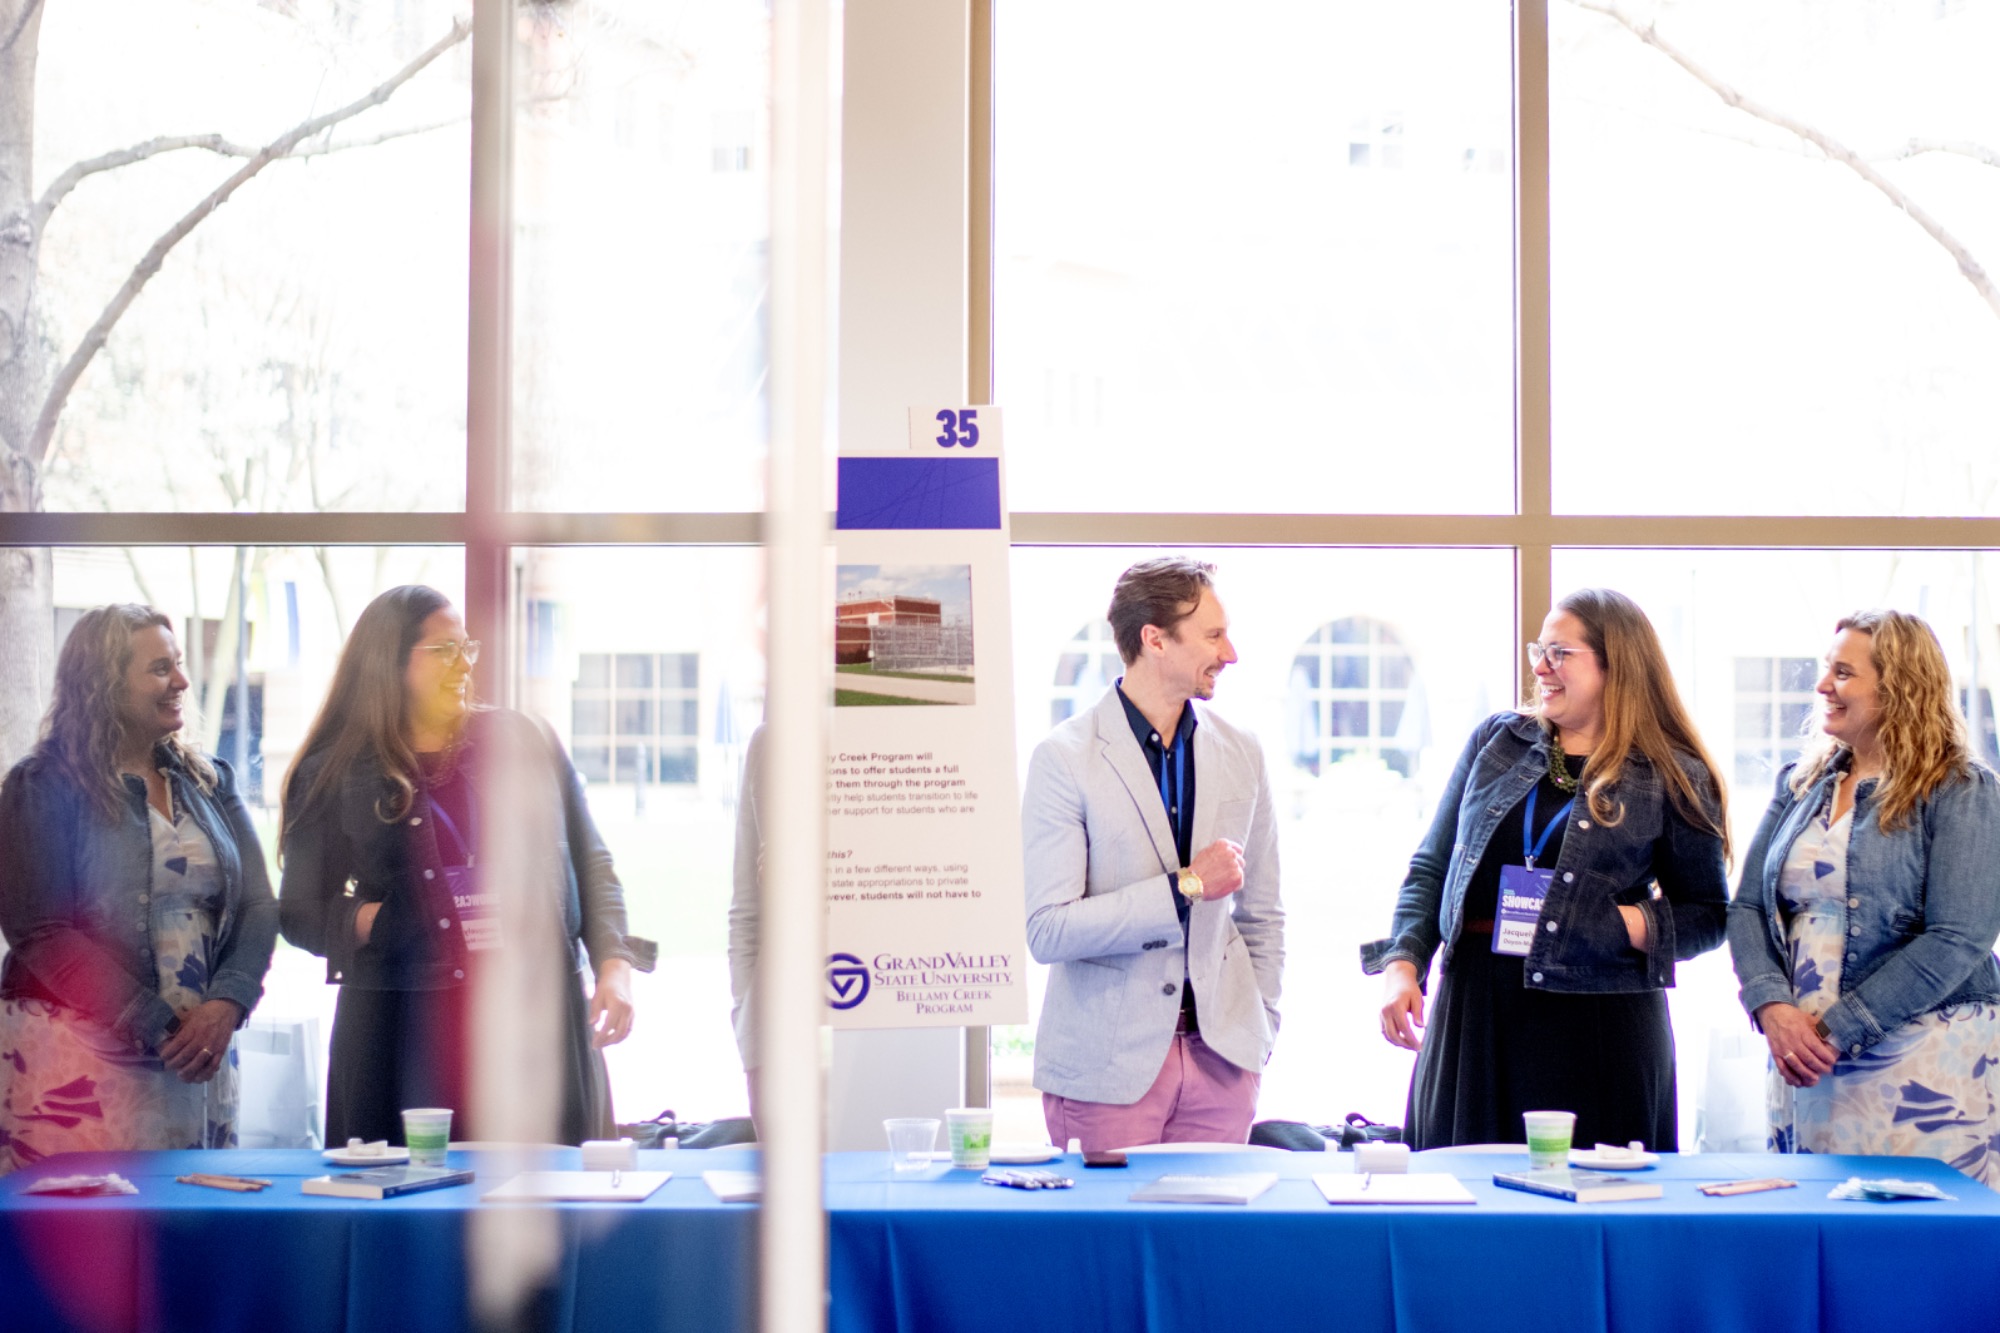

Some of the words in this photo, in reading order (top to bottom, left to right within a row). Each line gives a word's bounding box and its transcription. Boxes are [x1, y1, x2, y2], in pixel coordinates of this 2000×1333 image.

[936, 409, 979, 448] 35
[839, 752, 868, 762] Creek
[871, 752, 913, 763] Program
[916, 751, 933, 761] will
[850, 767, 861, 775] to
[863, 765, 886, 775] offer
[889, 764, 932, 774] students
[935, 766, 941, 774] a
[943, 764, 959, 774] full
[836, 779, 861, 788] them
[863, 779, 903, 790] through
[905, 778, 921, 787] the
[924, 779, 966, 789] program
[844, 793, 864, 804] help
[867, 792, 906, 802] students
[909, 791, 951, 801] transition
[953, 791, 963, 801] to
[965, 790, 979, 800] life
[844, 806, 879, 817] support
[881, 805, 893, 815] for
[896, 804, 936, 815] students
[938, 803, 957, 814] who
[960, 804, 976, 813] are
[835, 866, 844, 874] in
[855, 864, 871, 874] few
[874, 864, 912, 874] different
[943, 862, 969, 874] using
[831, 880, 855, 888] state
[857, 878, 924, 890] appropriations
[926, 877, 936, 886] to
[938, 876, 969, 888] private
[860, 891, 904, 901] students
[907, 890, 924, 900] will
[926, 890, 943, 899] not
[946, 889, 969, 899] have
[972, 888, 982, 898] to
[874, 972, 919, 986] STATE
[921, 971, 1012, 986] UNIVERSITY
[897, 990, 950, 1002] BELLAMY
[953, 989, 992, 1000] CREEK
[916, 1002, 973, 1014] PROGRAM
